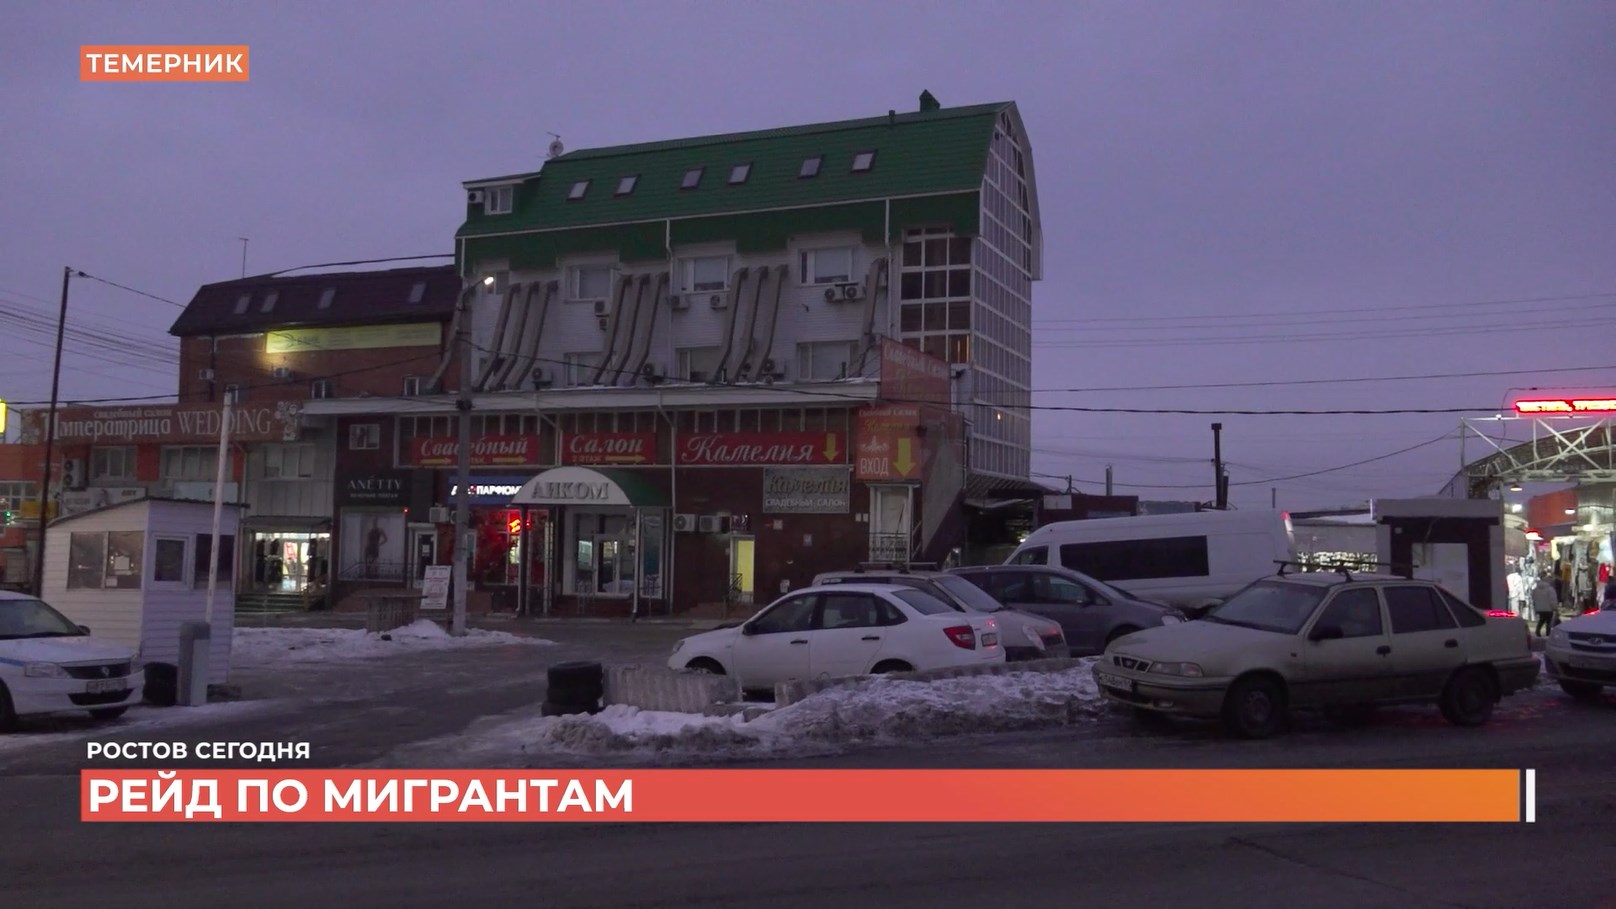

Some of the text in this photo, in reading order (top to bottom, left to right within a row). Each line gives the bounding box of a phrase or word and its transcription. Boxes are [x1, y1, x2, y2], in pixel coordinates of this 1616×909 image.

[570, 434, 644, 454] Салон
[681, 434, 815, 463] Камелия
[860, 457, 889, 476] ВХОД
